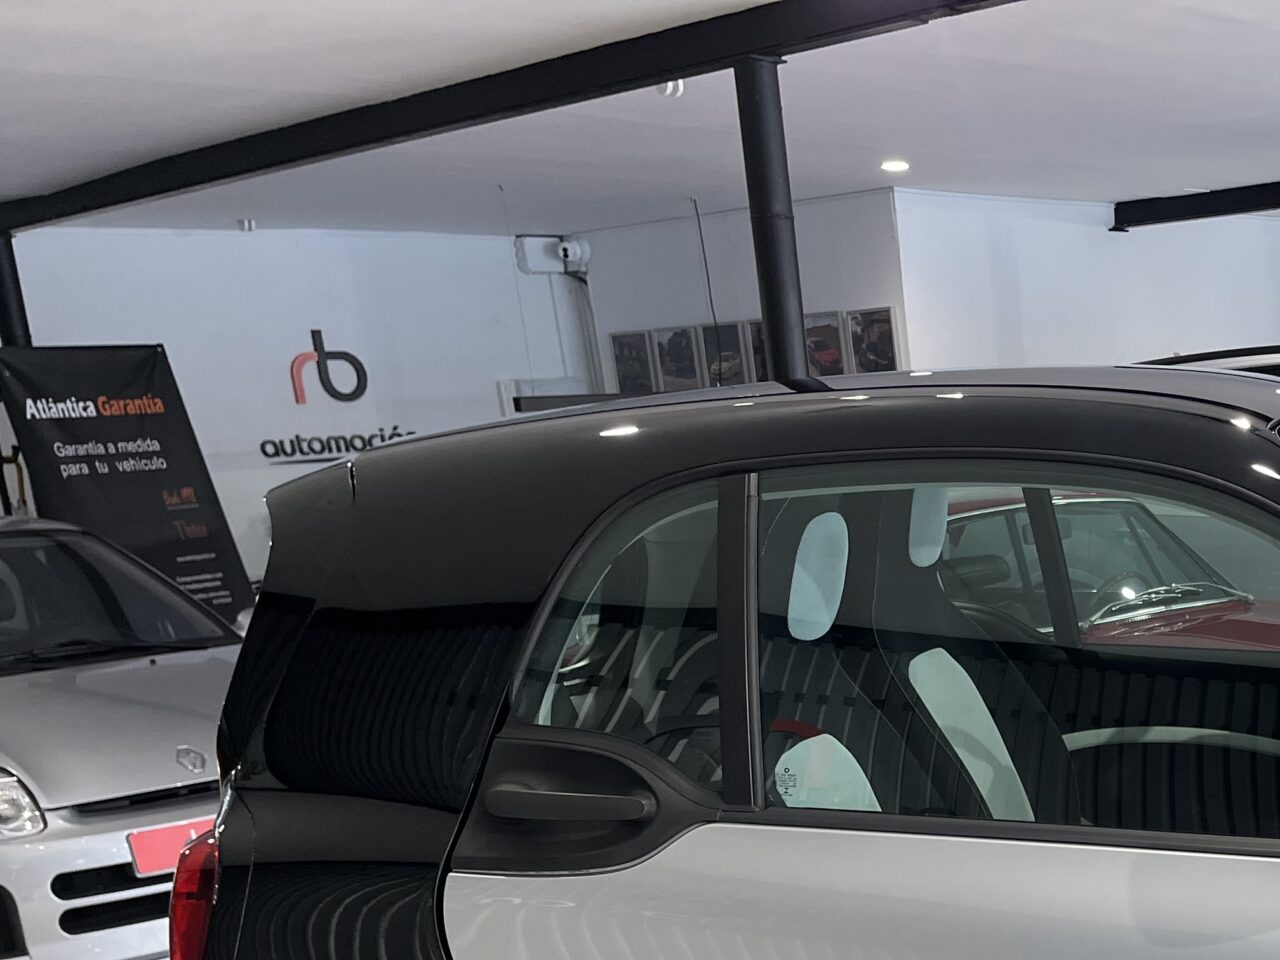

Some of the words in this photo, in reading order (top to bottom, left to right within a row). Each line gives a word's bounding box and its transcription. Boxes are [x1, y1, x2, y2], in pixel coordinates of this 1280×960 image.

[26, 396, 97, 419] Atlántica
[107, 442, 116, 455] a
[117, 437, 161, 454] medida
[60, 462, 90, 480] para
[95, 460, 109, 474] tu
